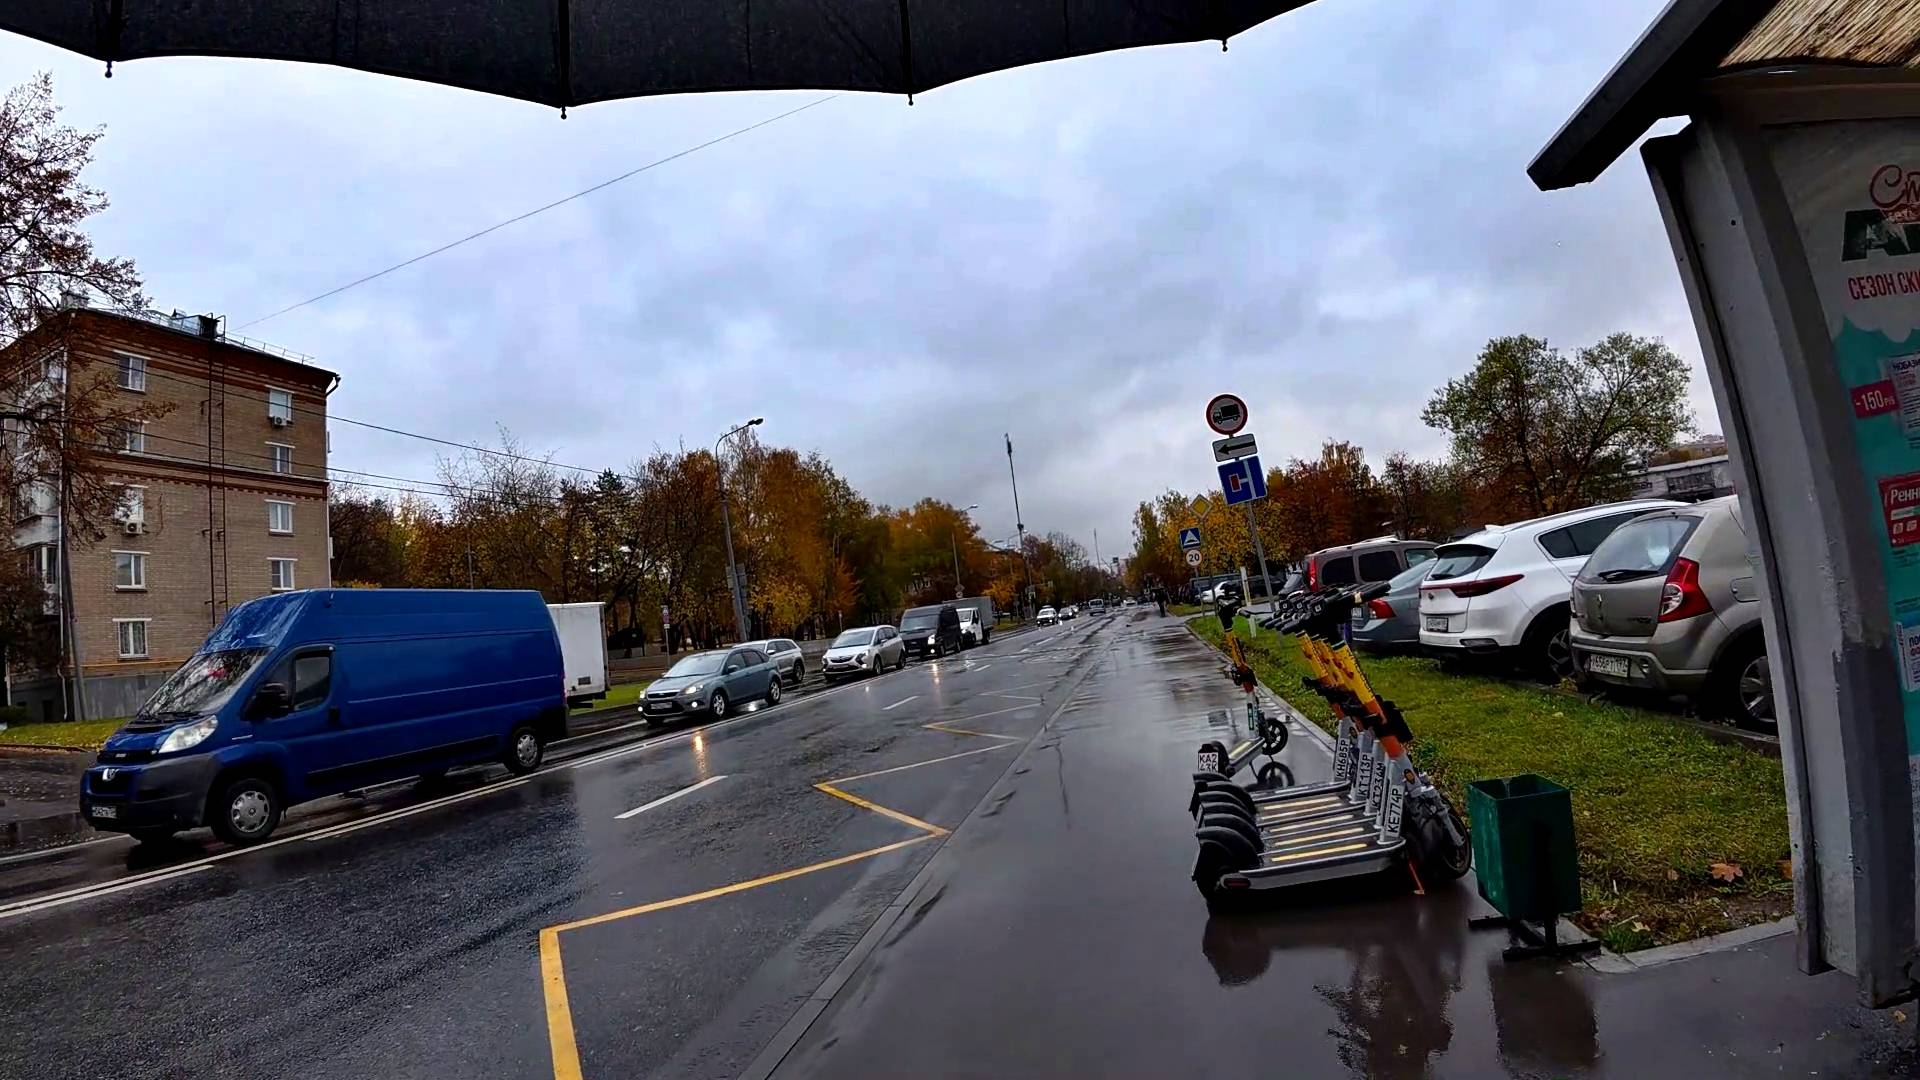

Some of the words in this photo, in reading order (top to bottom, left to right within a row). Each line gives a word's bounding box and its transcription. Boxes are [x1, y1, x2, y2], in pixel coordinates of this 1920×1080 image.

[1847, 273, 1897, 300] СЕЗОН
[1188, 553, 1200, 562] 20
[1387, 787, 1403, 833] КЕ774Р
